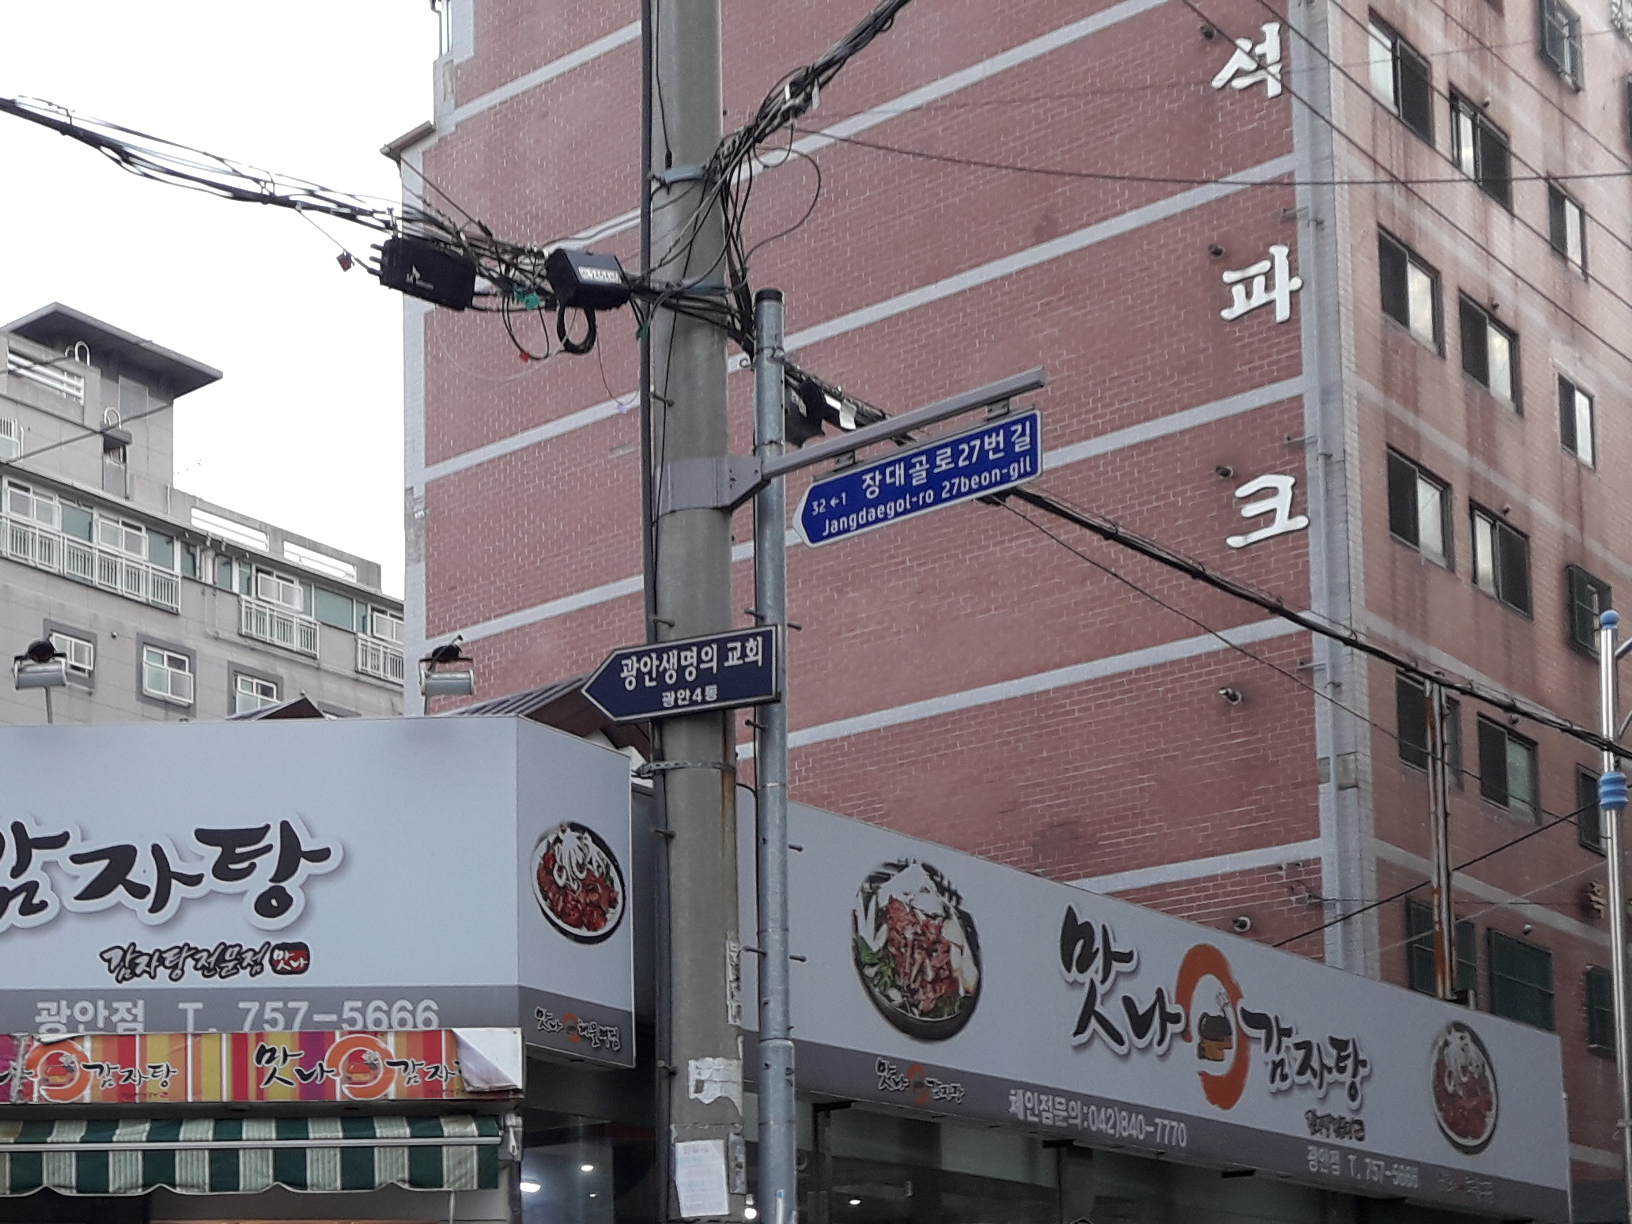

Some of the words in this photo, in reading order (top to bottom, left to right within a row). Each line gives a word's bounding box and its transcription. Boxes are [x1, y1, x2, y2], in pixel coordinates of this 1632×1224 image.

[862, 421, 1032, 499] 장대골로27번길
[811, 498, 827, 516] 32
[841, 492, 847, 506] 1
[822, 489, 934, 537] Jangdaegol-ro
[941, 455, 1032, 499] 27beon-gil
[620, 643, 718, 691] 광안생명의
[723, 636, 763, 668] 교회
[99, 941, 272, 985] 감자탕전문점
[273, 949, 308, 972] 맛나
[35, 1000, 146, 1033] 광안점
[237, 1000, 440, 1032] 757-5666
[1059, 903, 1183, 1048] 맛나
[1239, 1005, 1368, 1103] 감자탕
[81, 1062, 178, 1088] 감자탕
[255, 1043, 337, 1088] 맛나
[385, 1060, 463, 1086] 감자
